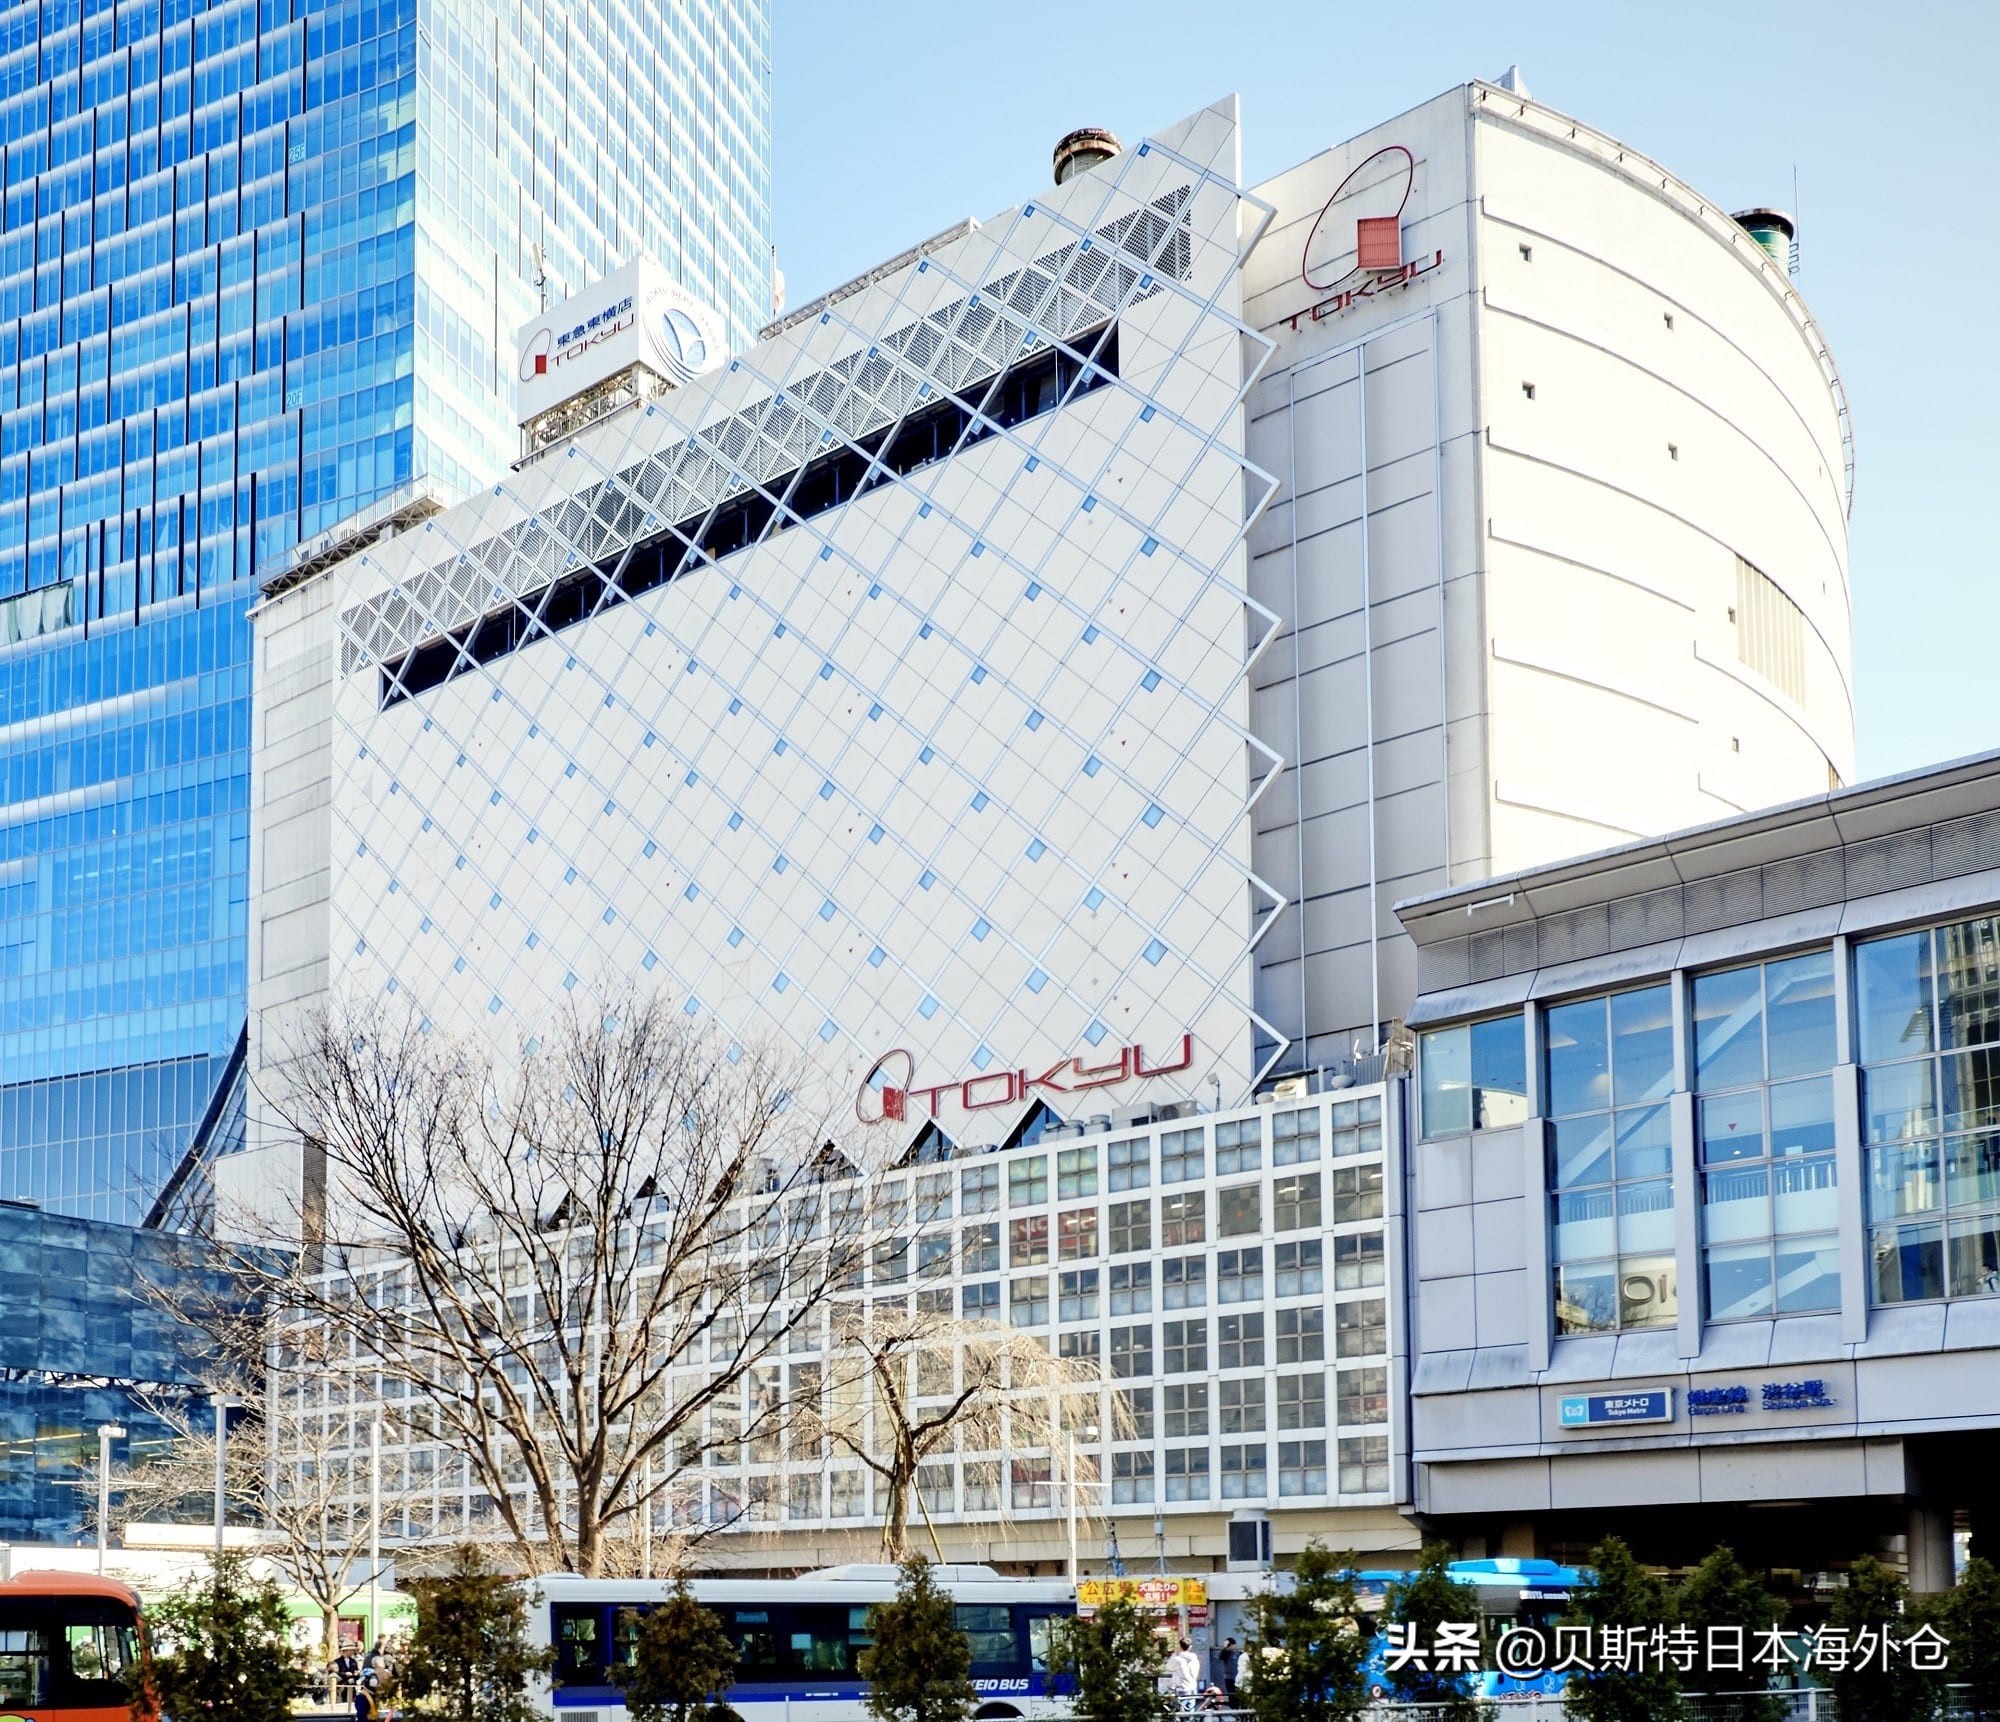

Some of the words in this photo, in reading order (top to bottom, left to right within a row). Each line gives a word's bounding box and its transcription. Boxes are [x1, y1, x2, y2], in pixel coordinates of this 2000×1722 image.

[289, 143, 304, 162] 25F
[1279, 249, 1444, 331] TOKYU
[556, 295, 633, 350] 東急東横店
[550, 313, 634, 367] TOKYU
[286, 390, 302, 408] 20F
[909, 1033, 1194, 1118] TOKYU
[1604, 1397, 1649, 1409] 東京メトロ
[1607, 1408, 1627, 1417] Tokyo
[1627, 1407, 1647, 1415] Metro
[998, 1678, 1029, 1690] BUS
